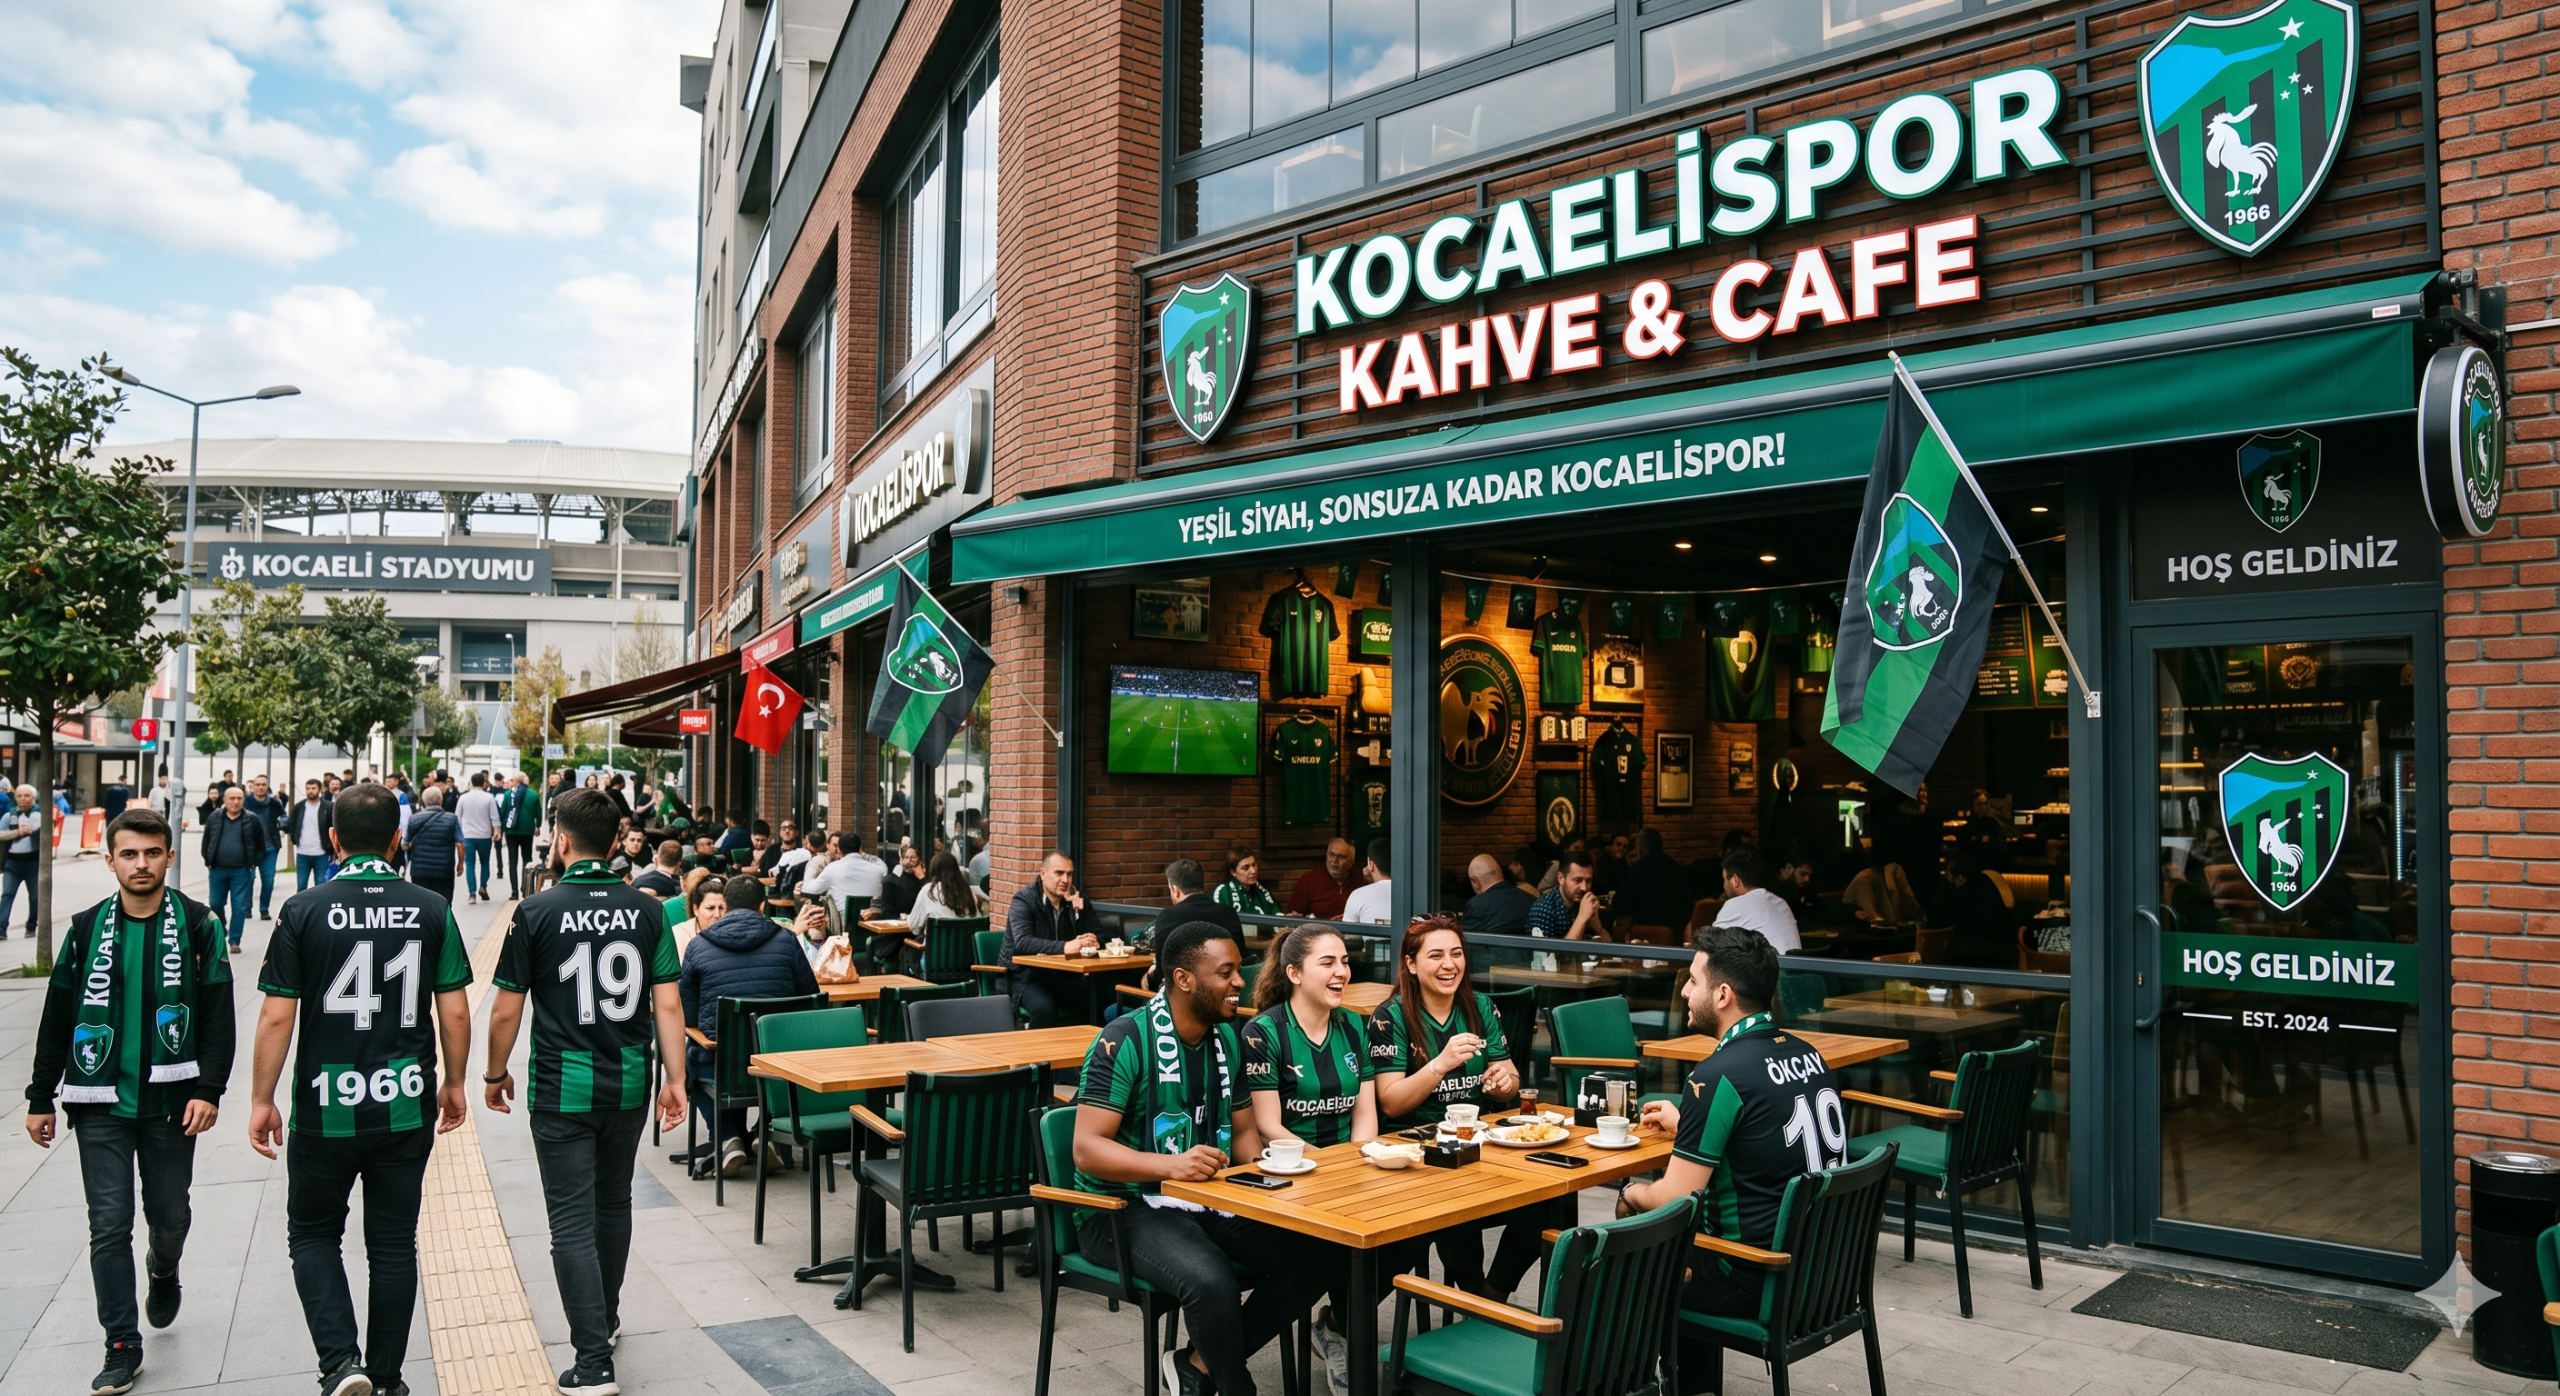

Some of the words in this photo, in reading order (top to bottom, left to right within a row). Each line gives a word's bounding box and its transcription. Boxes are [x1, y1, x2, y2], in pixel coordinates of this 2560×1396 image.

[1296, 65, 2069, 336] KOCAELİSPOR
[2223, 203, 2271, 226] 1966
[1339, 293, 1601, 414] KAHVE
[1622, 279, 1686, 360] &
[1710, 214, 1981, 344] CAFE
[854, 431, 945, 544] KOCAELİSPOR
[1178, 506, 1237, 545] YEŞİL
[1241, 500, 1314, 535] SİYAH,
[1319, 482, 1440, 526] SONSUZA
[1446, 467, 1543, 509] KADAR
[1551, 432, 1786, 495] KOCAELİSPOR!
[252, 551, 373, 578] KOCAELİ
[380, 556, 534, 581] STADYUMU
[2168, 553, 2233, 583] HOŞ
[2242, 535, 2398, 577] GELDİNİZ
[2270, 881, 2297, 892] 1966
[327, 903, 421, 930] ÖLMEZ
[559, 909, 640, 936] AKÇAY
[323, 940, 422, 1031] 41
[558, 940, 643, 1025] 19
[2183, 948, 2242, 982] HOŞ
[2250, 951, 2396, 987] GELDİNİZ
[2242, 1010, 2280, 1029] EST.
[2284, 1013, 2330, 1033] 2024
[311, 1064, 425, 1107] 1966
[1765, 1052, 1825, 1085] ÖKÇAY
[1783, 1088, 1848, 1172] 19
